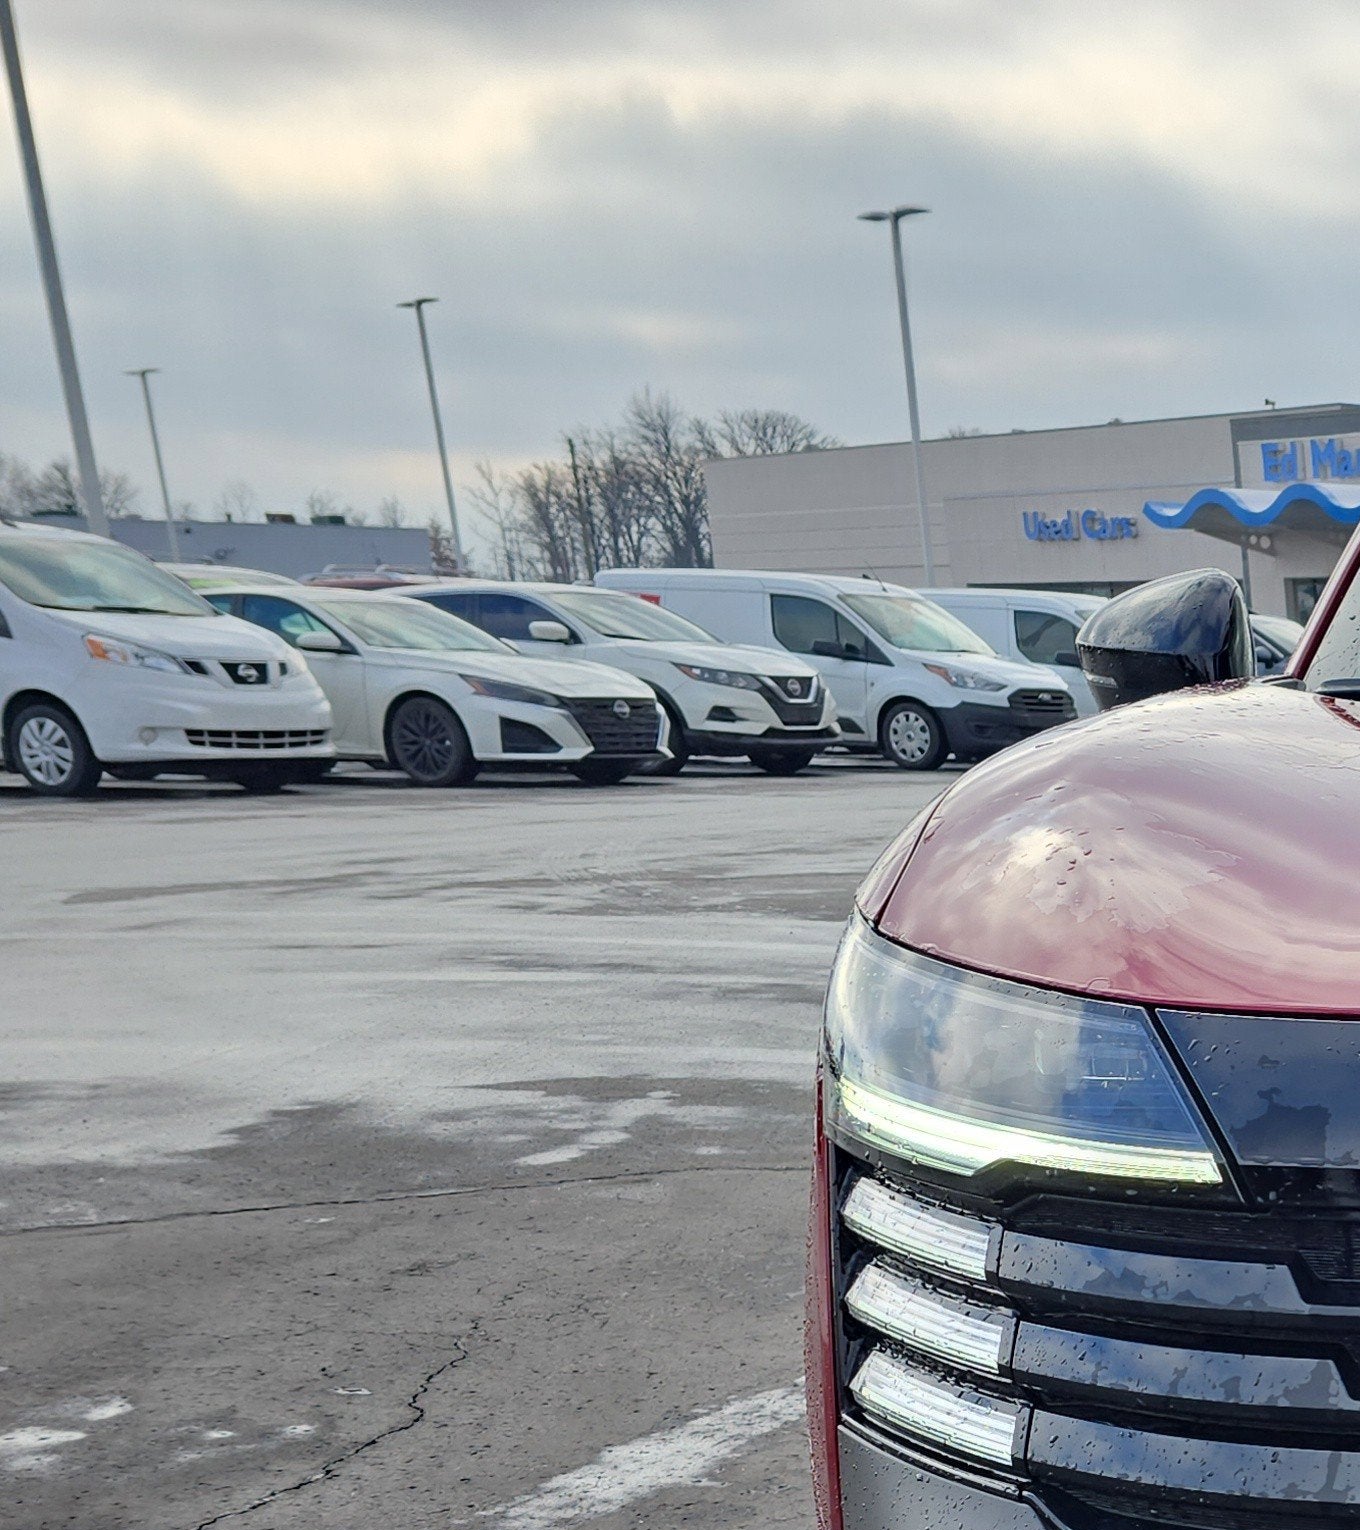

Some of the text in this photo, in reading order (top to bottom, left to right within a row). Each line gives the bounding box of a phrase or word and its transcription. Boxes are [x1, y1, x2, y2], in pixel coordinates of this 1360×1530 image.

[1261, 441, 1298, 482] Ed
[1023, 509, 1135, 541] Used Cars
